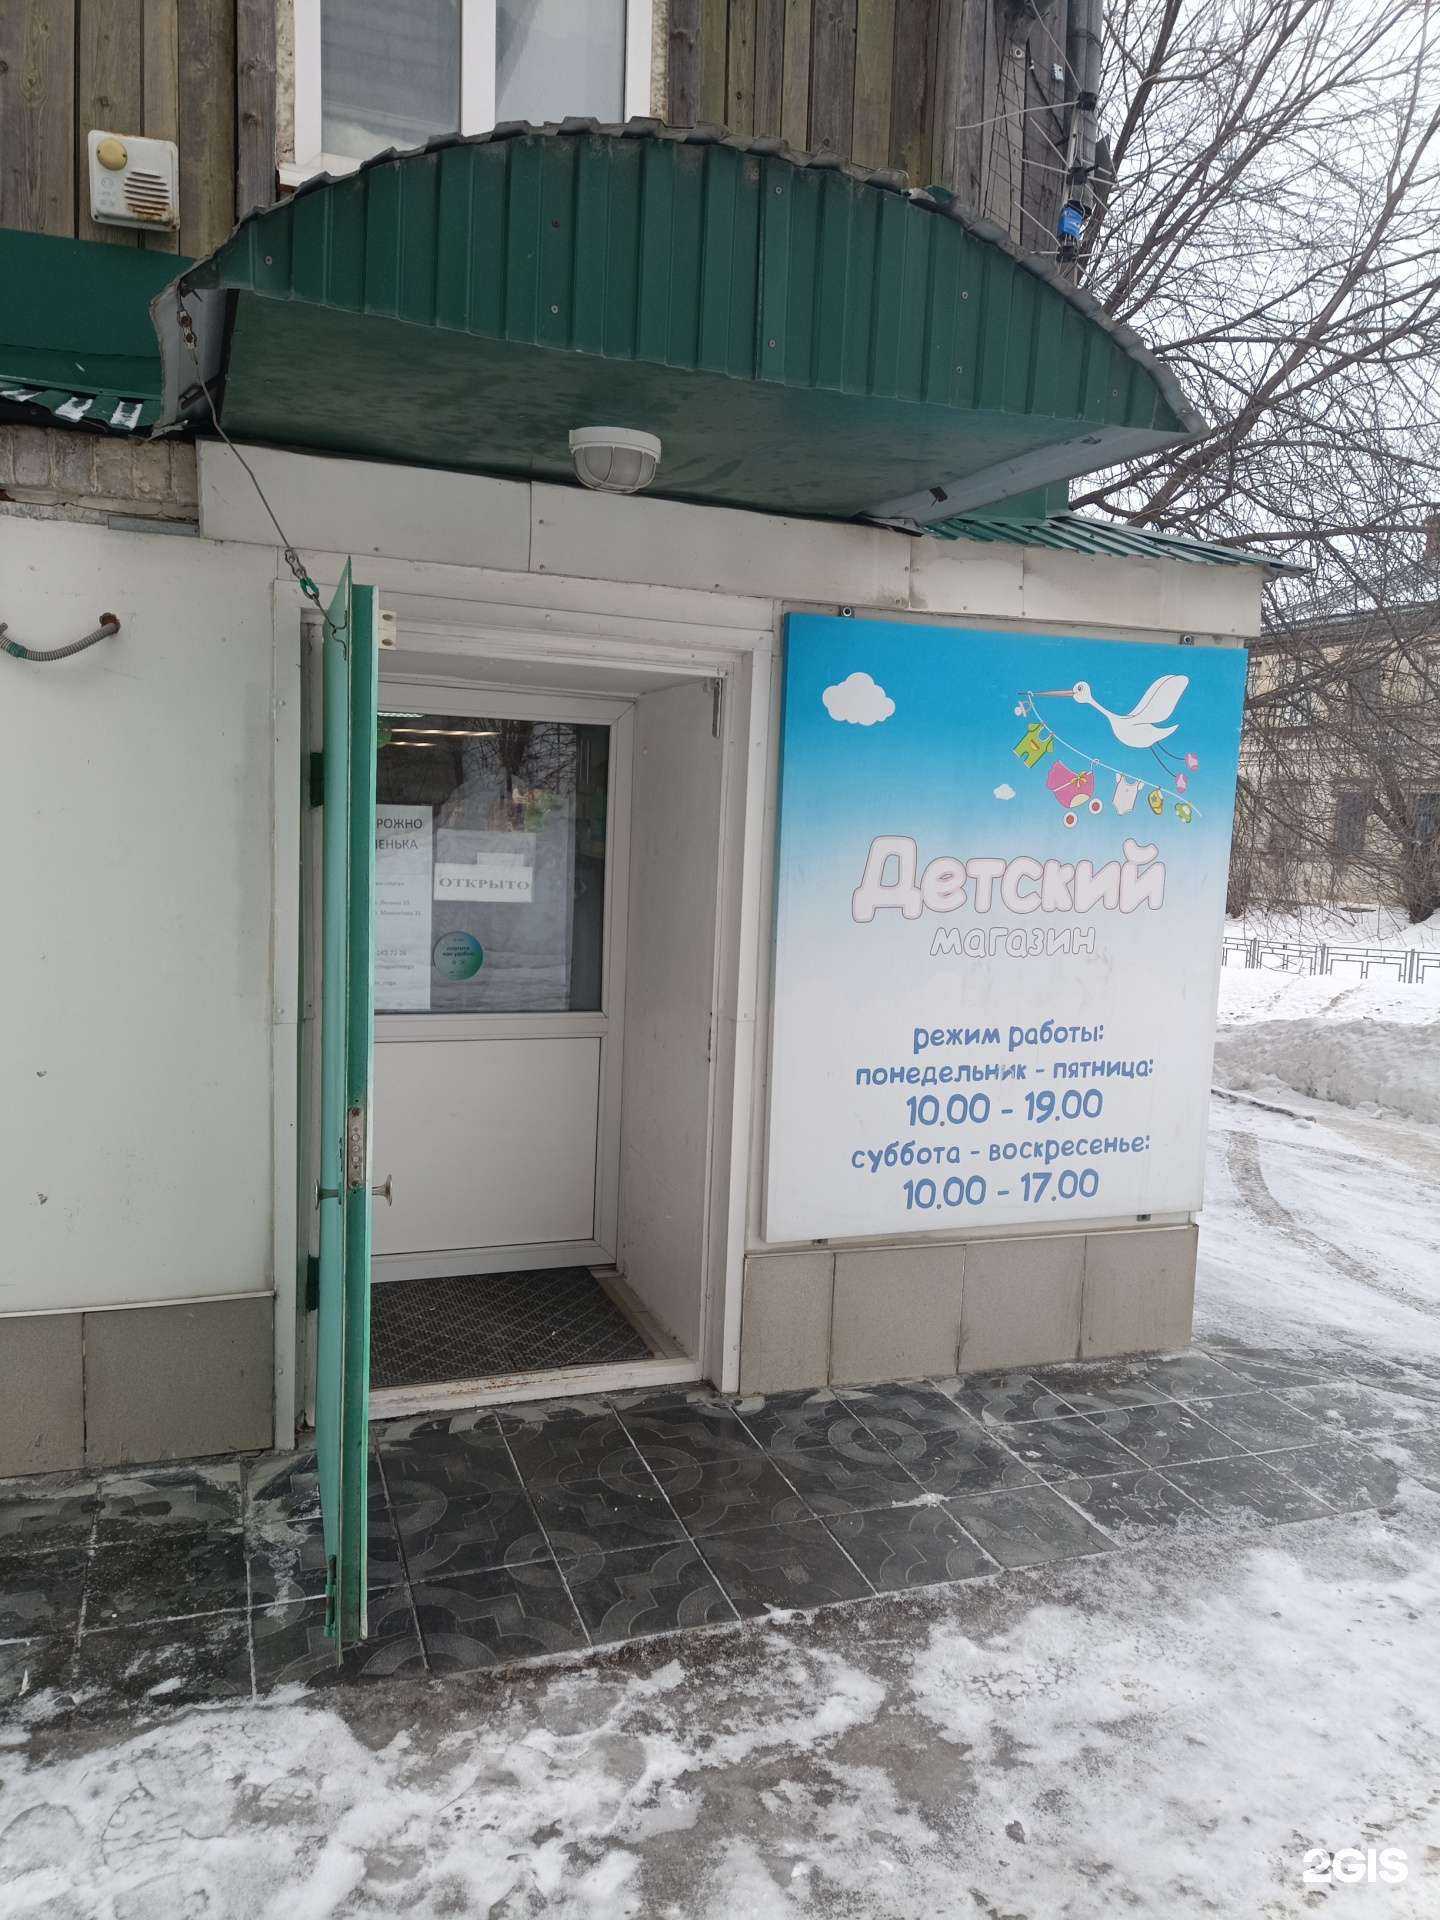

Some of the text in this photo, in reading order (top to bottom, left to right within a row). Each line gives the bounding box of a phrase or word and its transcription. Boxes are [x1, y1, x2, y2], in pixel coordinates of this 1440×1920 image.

[376, 818, 423, 829] РОЖНО
[375, 839, 418, 850] ЕНЬКА
[439, 878, 530, 890] ОТКРЫТО
[851, 835, 1166, 923] Детский
[929, 926, 1096, 958] магазин
[913, 1019, 1104, 1054] режим работы:
[855, 1063, 1027, 1086] понедельник
[1053, 1058, 1154, 1080] пятница:
[905, 1092, 991, 1127] 10.00
[1024, 1088, 1104, 1124] 19.00
[851, 1140, 961, 1173] суббота
[989, 1135, 1151, 1165] воскресенье:
[903, 1174, 987, 1210] 10.00
[1020, 1168, 1100, 1203] 17.00
